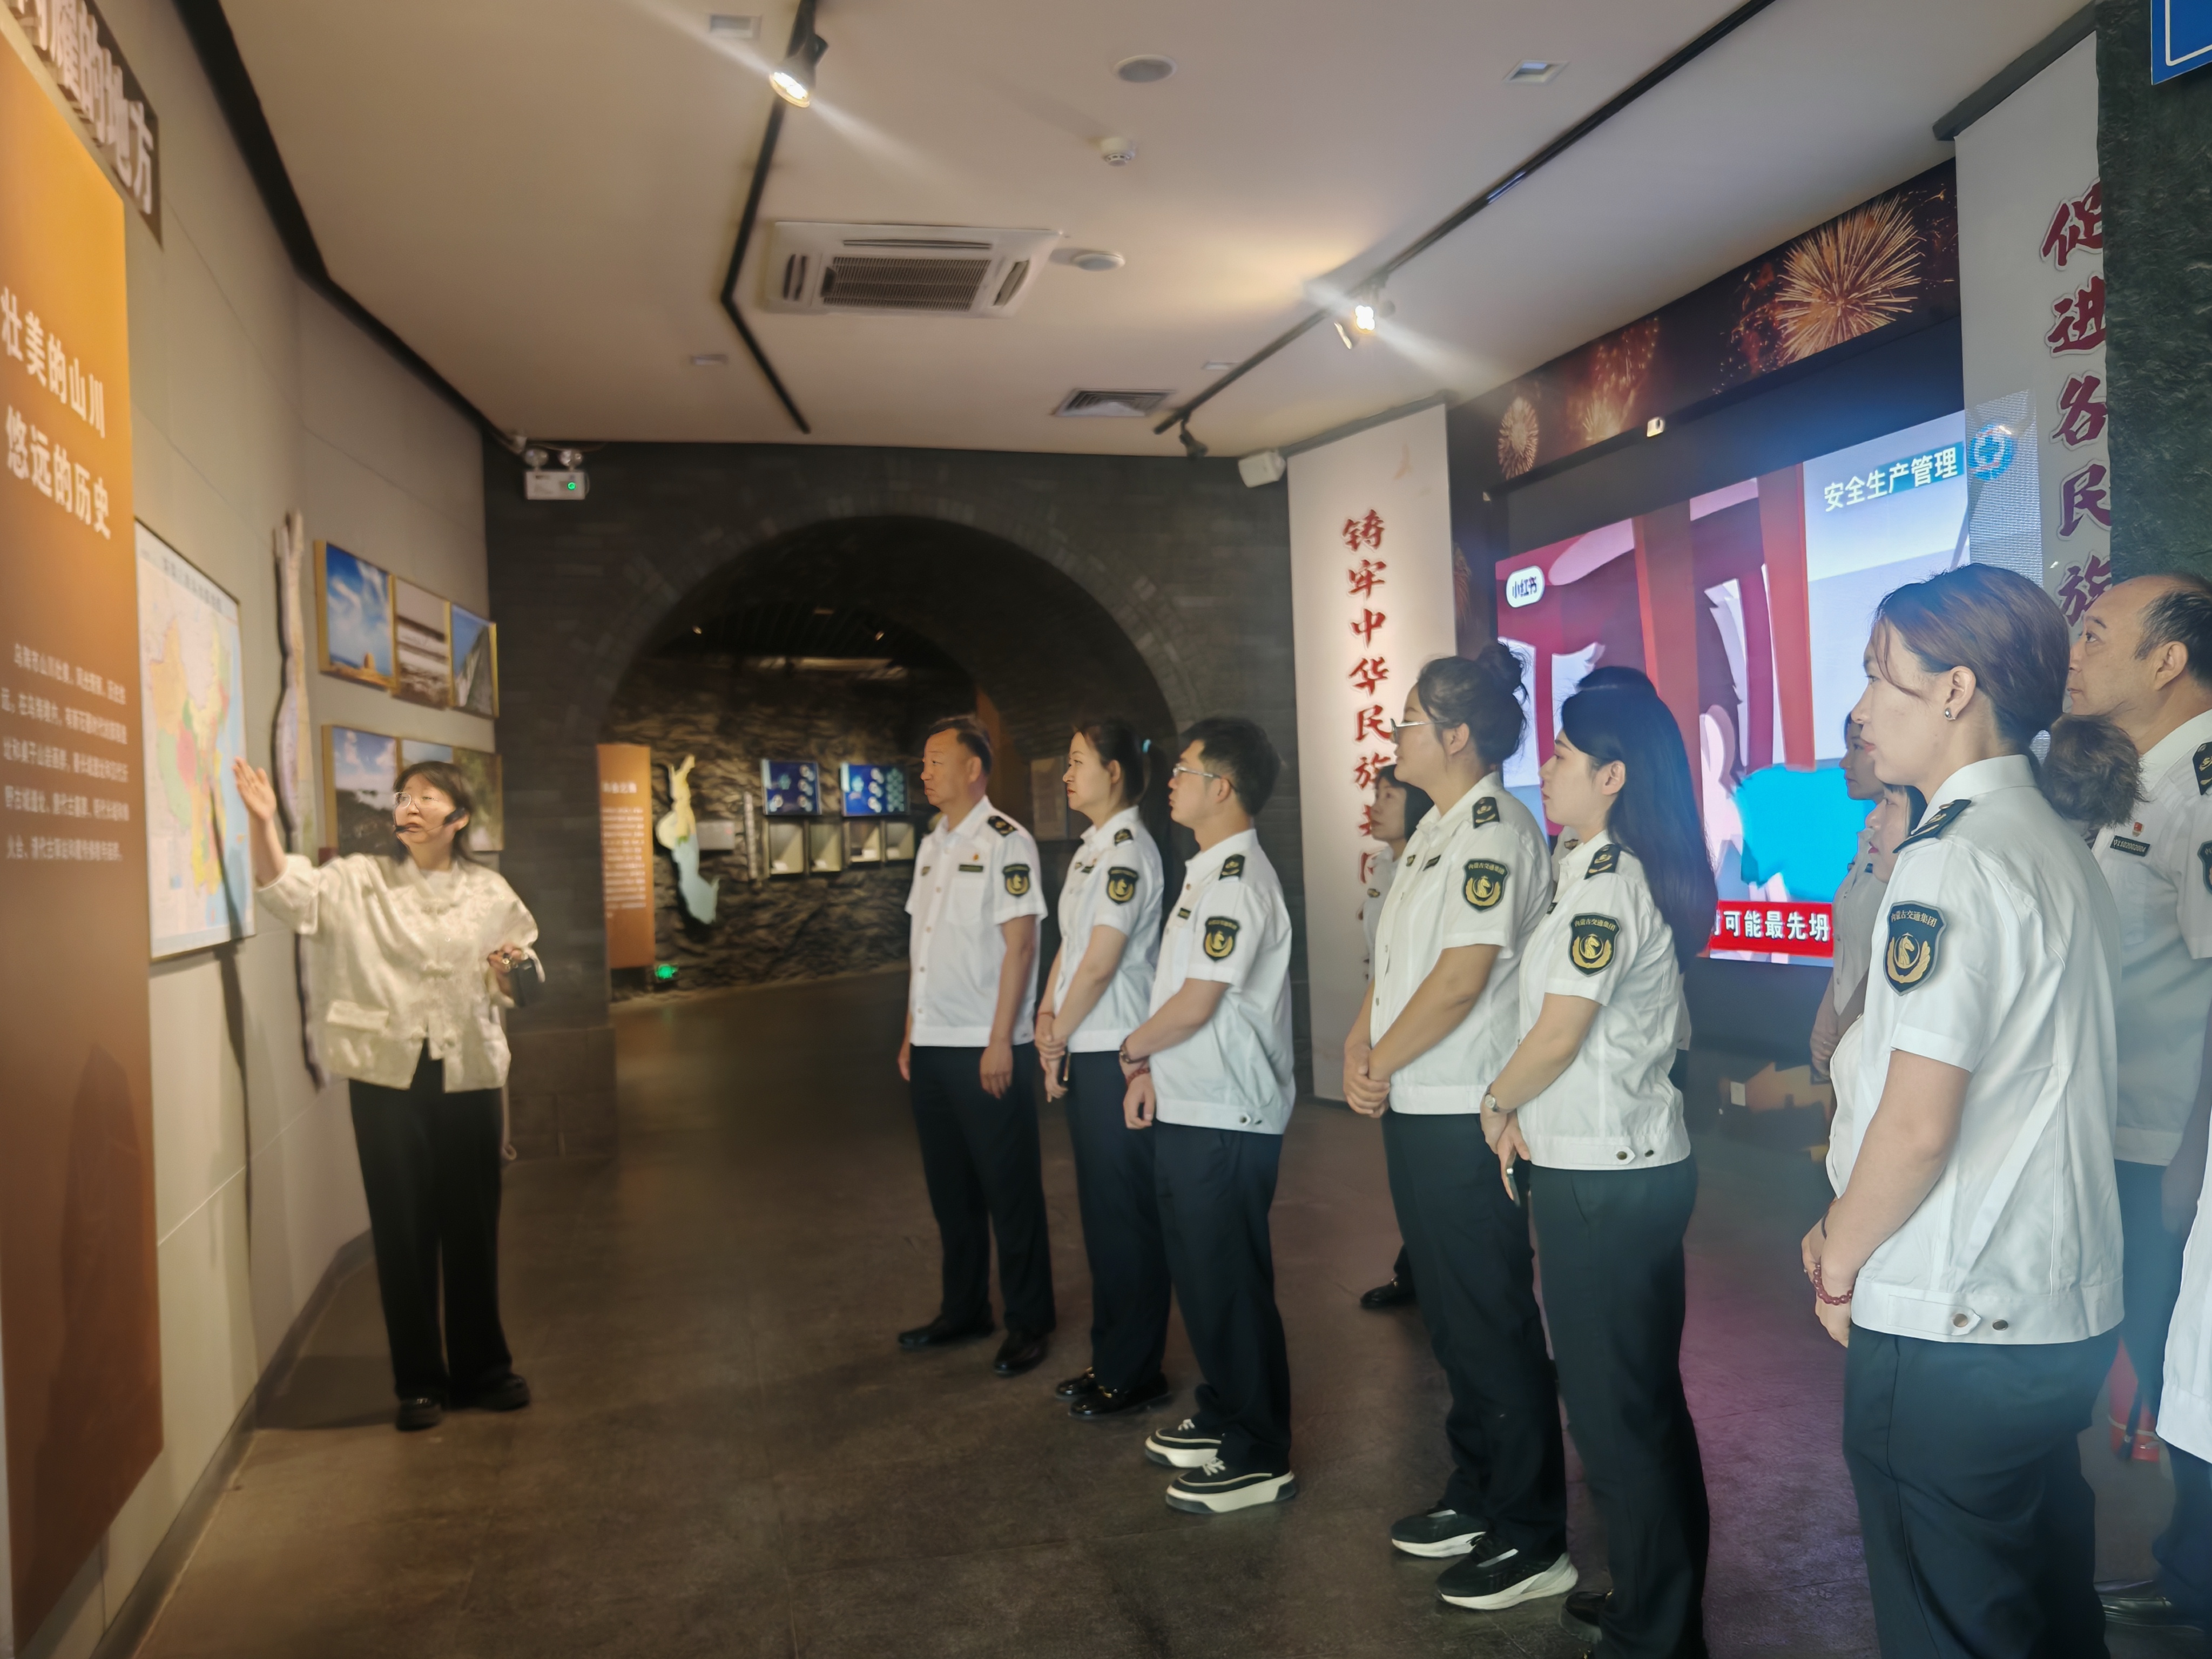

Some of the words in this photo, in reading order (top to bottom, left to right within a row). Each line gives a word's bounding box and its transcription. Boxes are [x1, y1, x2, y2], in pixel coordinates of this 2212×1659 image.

[1, 286, 105, 439] 壮美的山川
[5, 404, 111, 540] 悠远的历史
[1824, 447, 1958, 512] 安全生产管理
[1512, 576, 1537, 599] 小红书
[1341, 509, 1393, 980] 铸牢中华民族
[1891, 909, 1938, 928] 内蒙古交通集团
